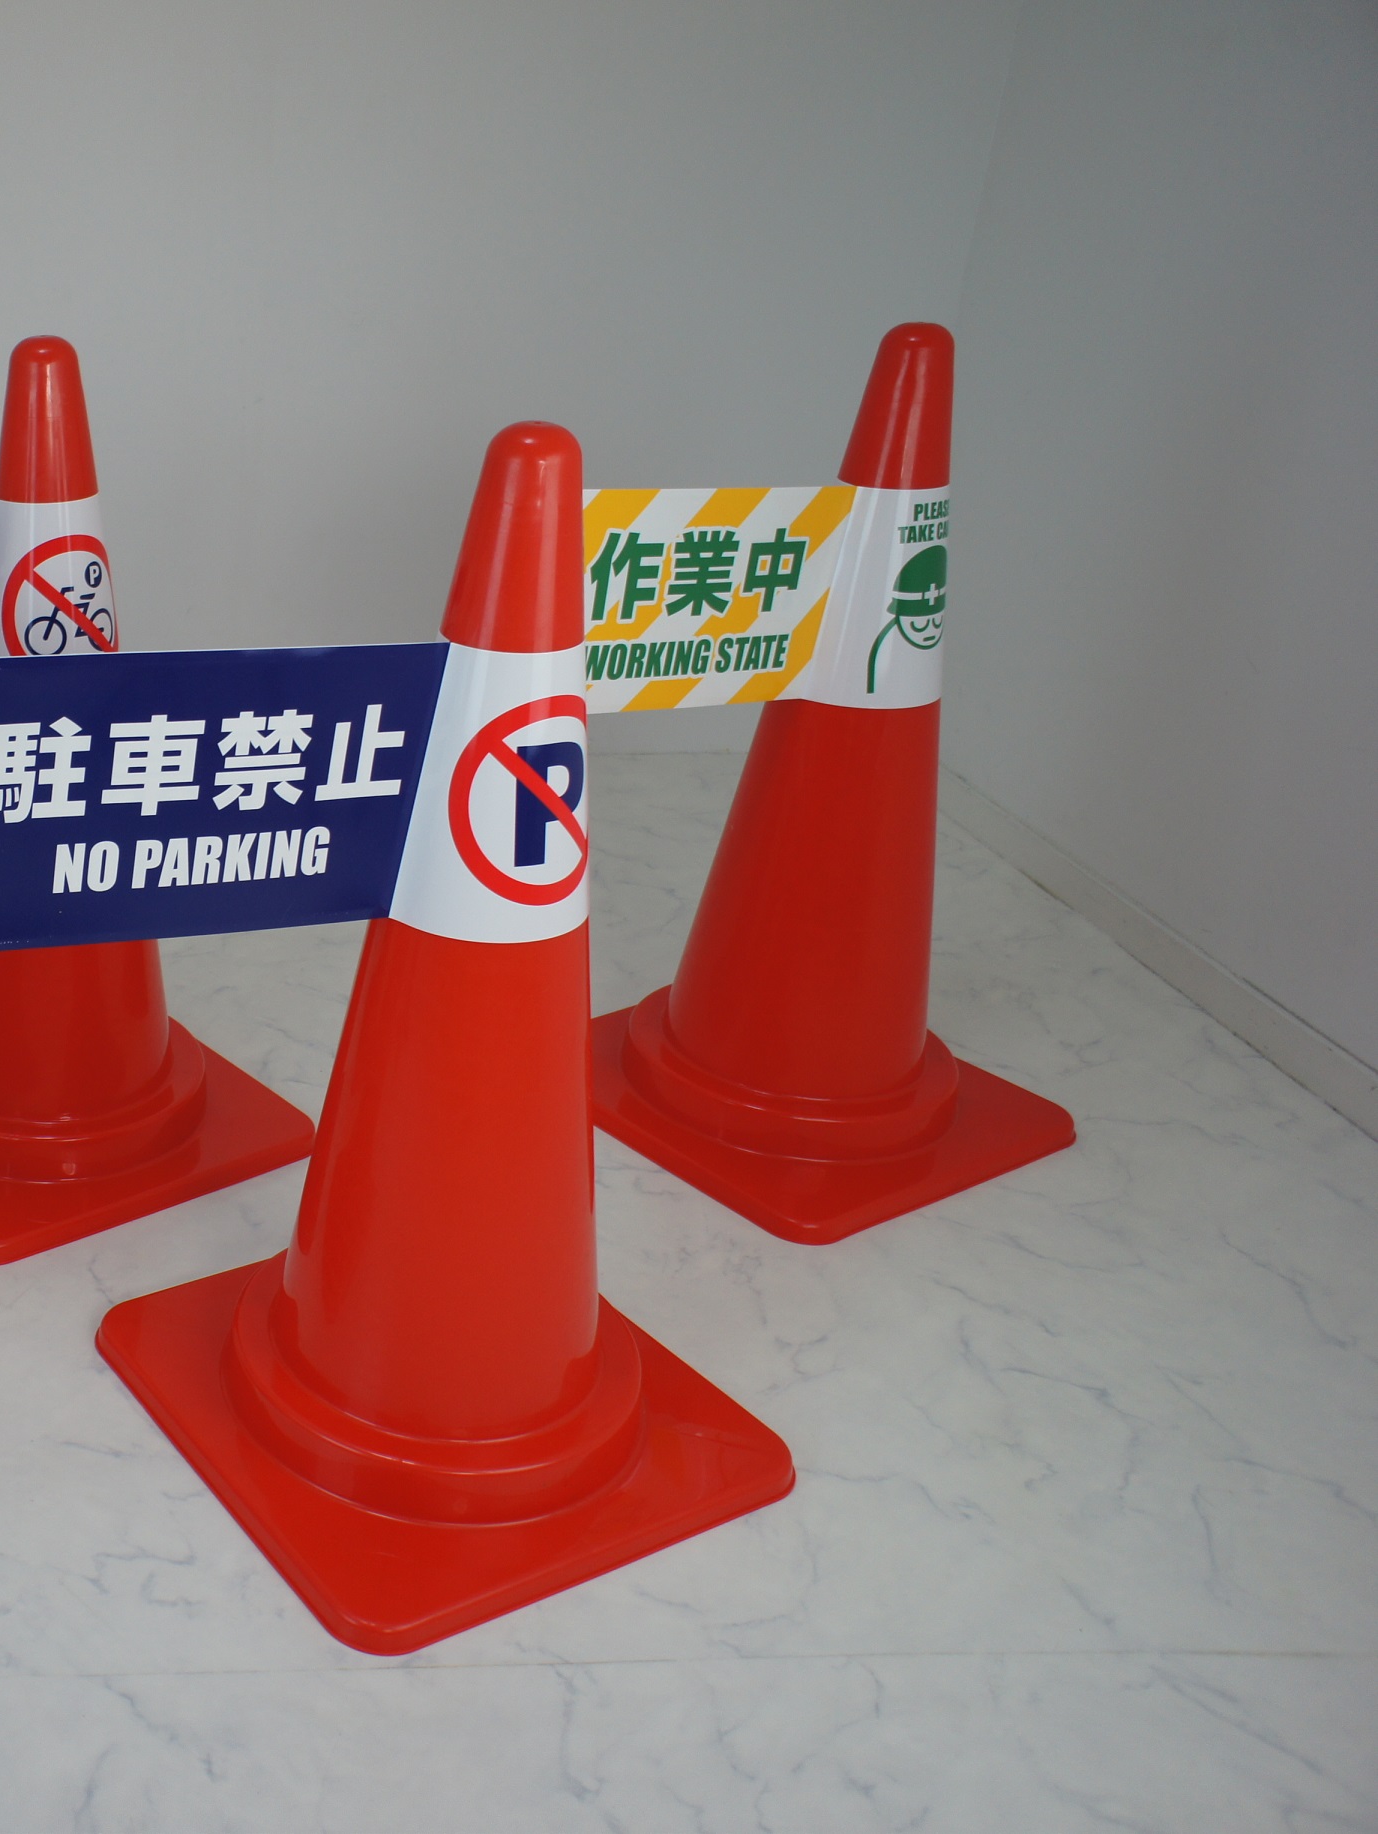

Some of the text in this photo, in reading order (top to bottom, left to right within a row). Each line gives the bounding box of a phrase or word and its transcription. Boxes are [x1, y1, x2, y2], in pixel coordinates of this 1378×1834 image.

[898, 523, 935, 544] TAKE
[913, 499, 950, 521] PLEAS
[89, 565, 100, 585] P
[589, 527, 809, 622] 作業中
[586, 633, 790, 681] WORKING STATE
[513, 740, 585, 868] P
[52, 826, 331, 894] NO PARKING
